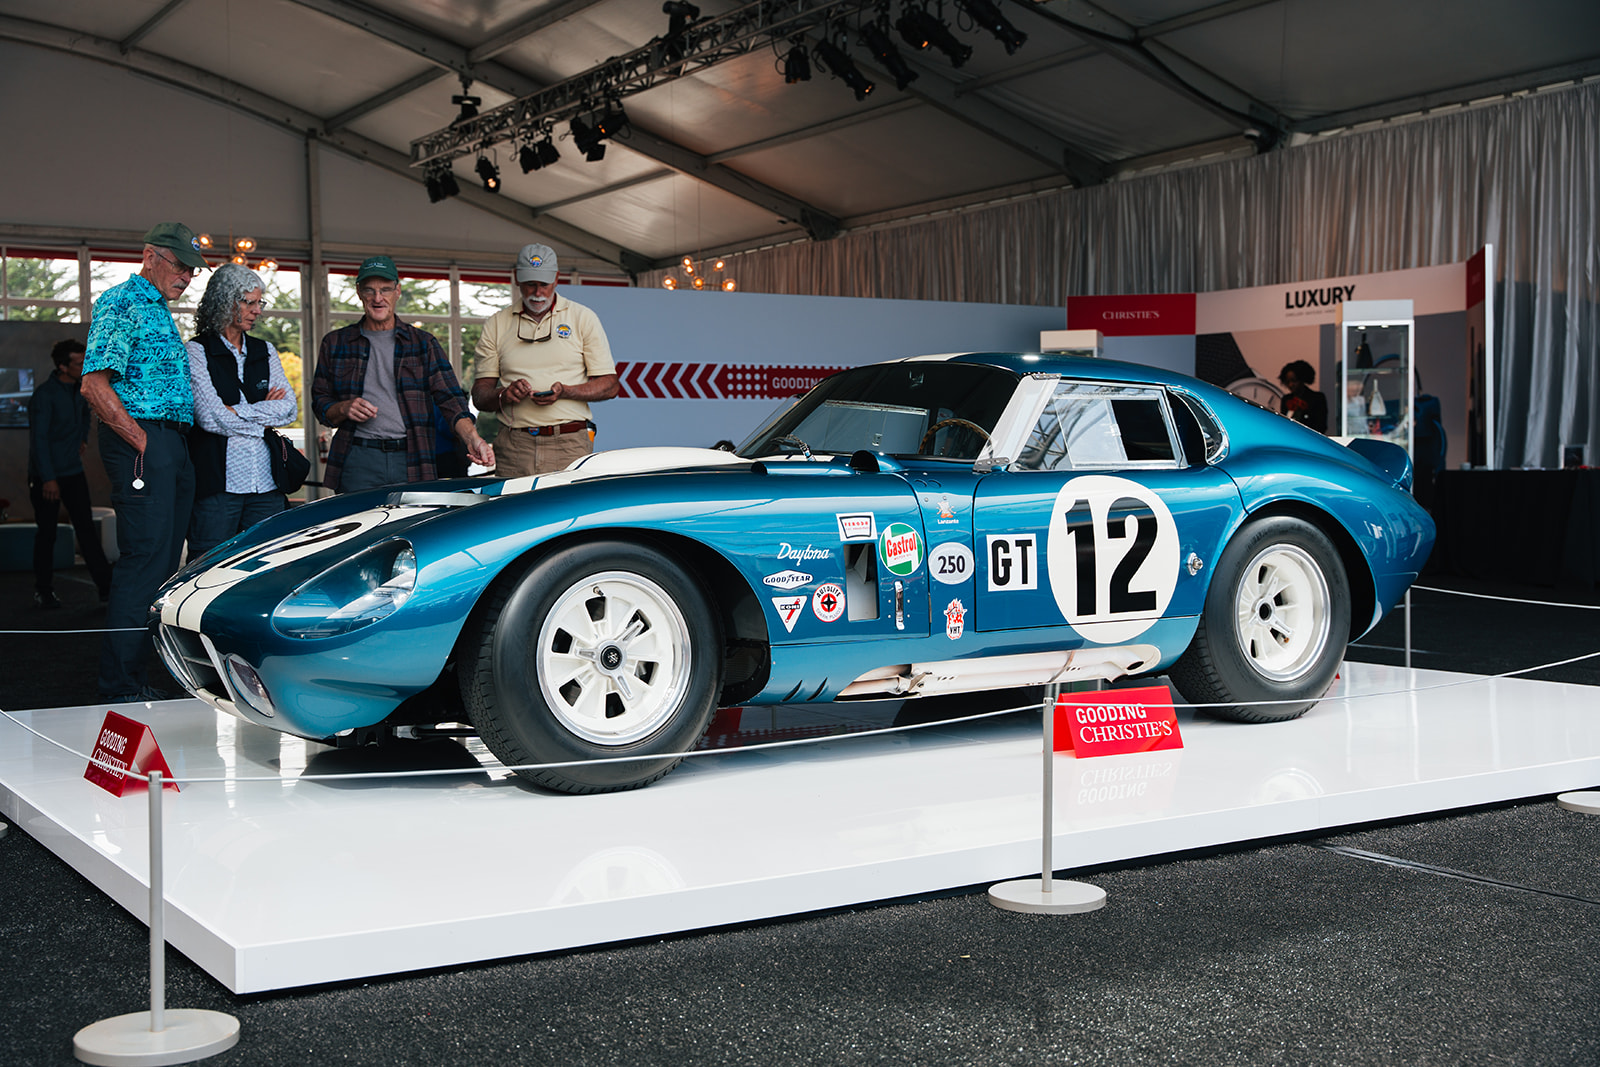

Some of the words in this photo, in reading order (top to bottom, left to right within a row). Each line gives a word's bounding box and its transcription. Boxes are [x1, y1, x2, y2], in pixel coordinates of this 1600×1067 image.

[1285, 284, 1356, 309] LUXURY
[772, 376, 824, 389] GOODIN
[777, 542, 830, 566] Daytona
[886, 533, 917, 557] Castrol
[1065, 496, 1158, 616] 12
[938, 555, 966, 574] 250
[991, 539, 1033, 586] GT
[816, 585, 842, 598] AUTOLITE
[1075, 703, 1147, 724] GOODING
[99, 728, 128, 755] GOODING
[1079, 720, 1173, 743] CHRISTIE'S
